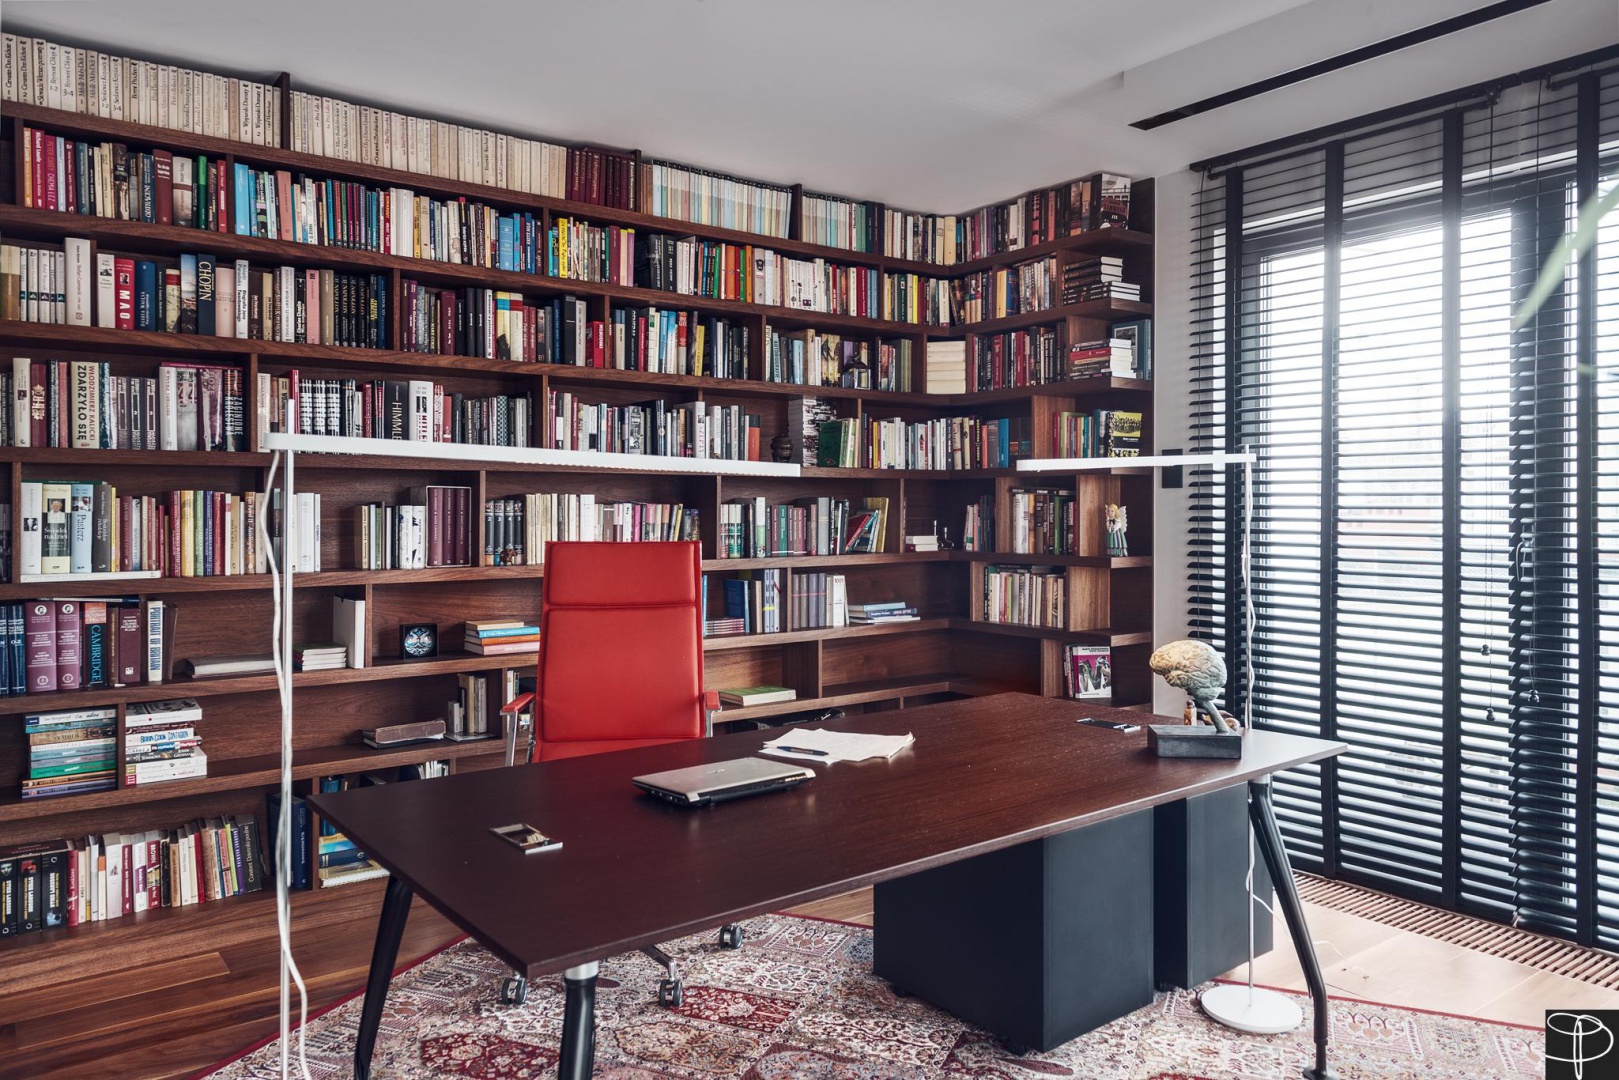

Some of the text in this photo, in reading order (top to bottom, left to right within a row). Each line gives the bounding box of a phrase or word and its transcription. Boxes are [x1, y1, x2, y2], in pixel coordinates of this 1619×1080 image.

[198, 261, 211, 301] CHOPIN
[119, 289, 130, 319] MAO
[76, 365, 87, 441] ZDARZYŁO SIĘ
[233, 396, 243, 435] ZAGINIONE
[392, 402, 402, 440] HIMMLE
[77, 514, 87, 542] Pasterz
[91, 624, 102, 682] CAMBRIDGE
[149, 607, 161, 671] PORTRAIT OF BRITAIN
[247, 862, 255, 882] Constant
